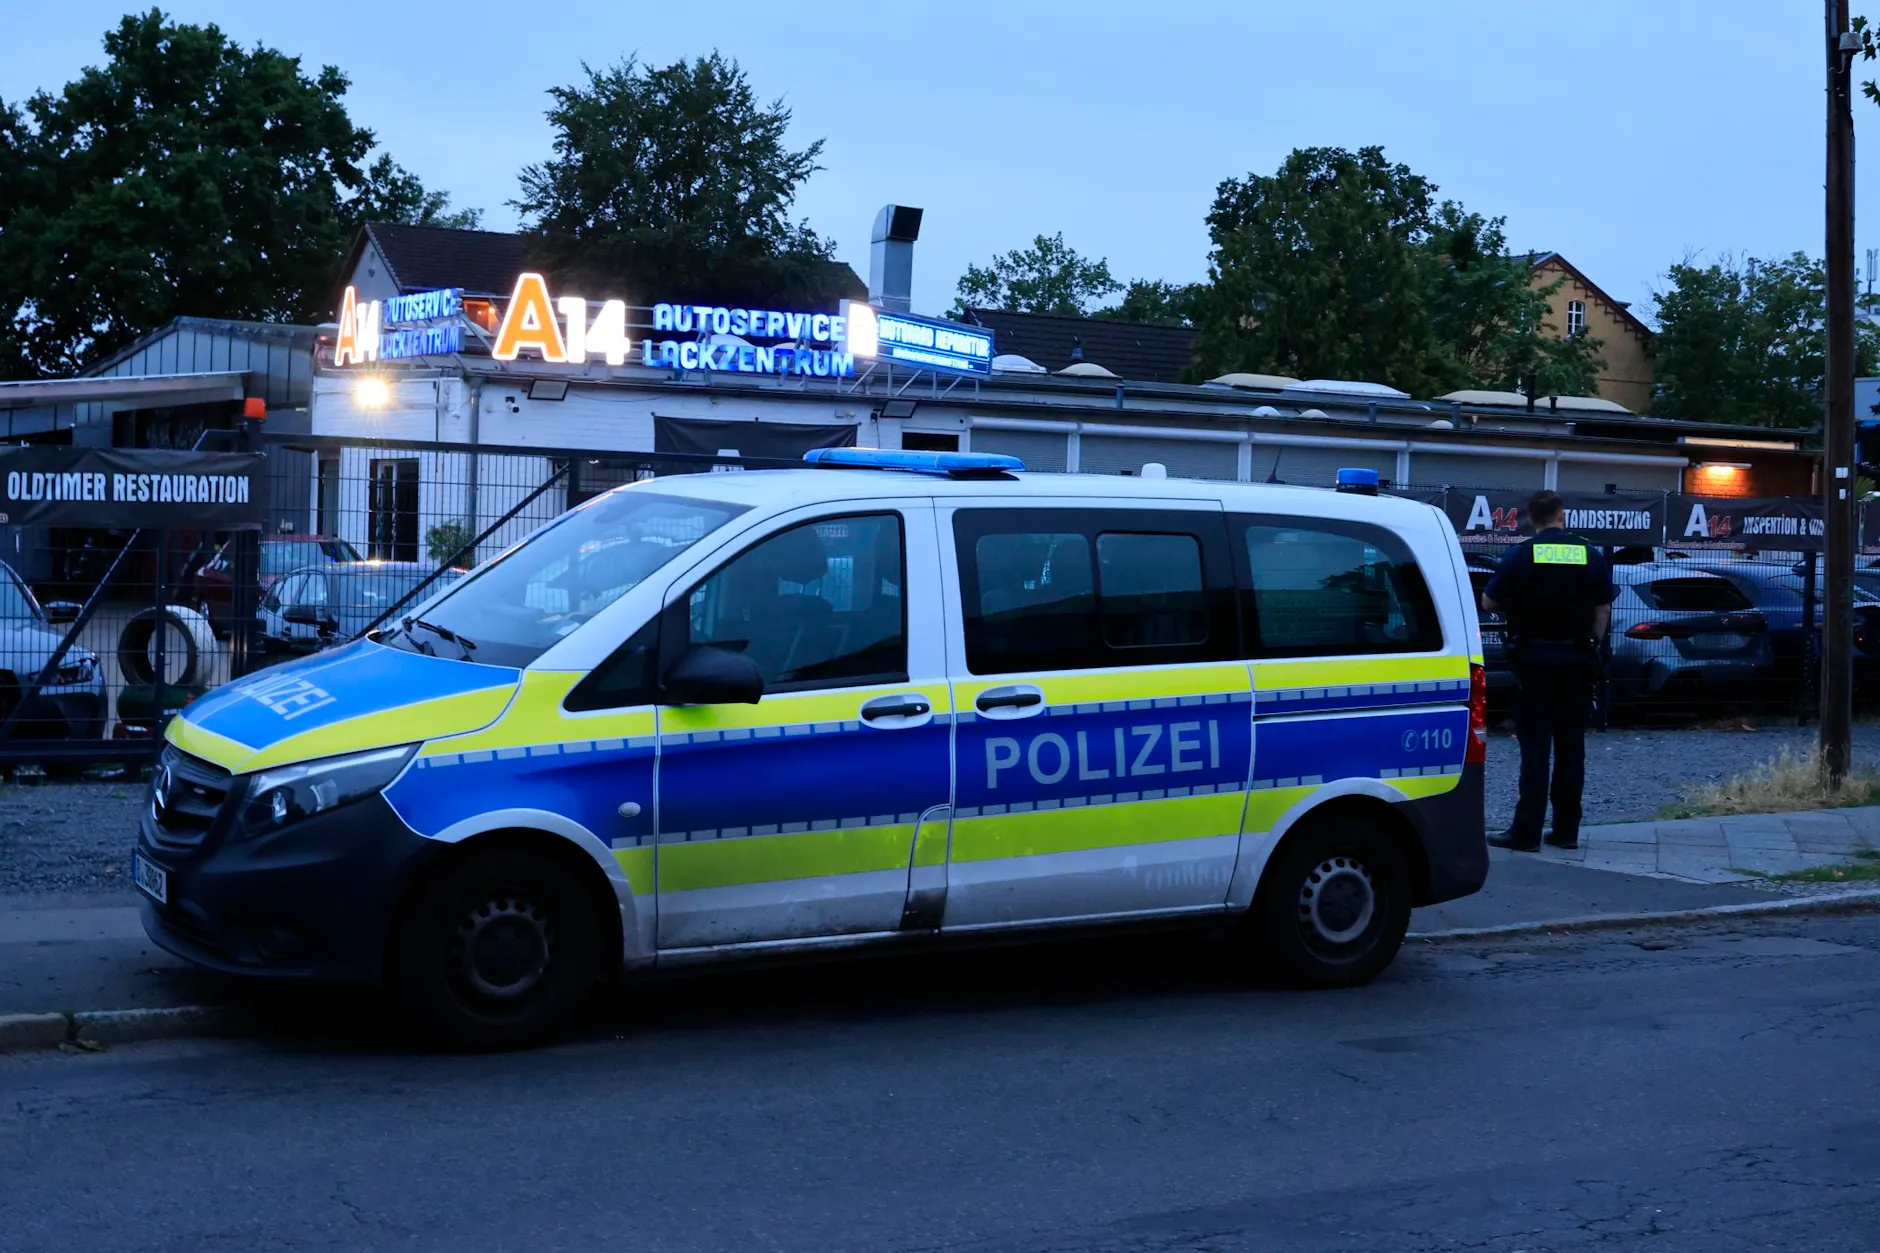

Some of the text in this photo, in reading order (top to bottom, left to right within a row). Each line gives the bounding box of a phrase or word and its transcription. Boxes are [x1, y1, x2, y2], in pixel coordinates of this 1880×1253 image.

[384, 288, 460, 323] AUTOSERVICE
[492, 272, 631, 366] A14
[653, 302, 847, 342] AUTOSERVICE
[335, 286, 379, 366] A14
[379, 326, 460, 359] LACKZENTRUM
[643, 339, 855, 378] LACKZENTRUM
[7, 471, 249, 504] OLDTIMER RESTAURATION
[1465, 495, 1519, 532] A14
[1563, 508, 1651, 531] TANDSETZUNG
[1684, 503, 1733, 538] A14
[1535, 545, 1586, 564] POLIZEI
[985, 719, 1221, 789] POLIZEI
[1420, 728, 1453, 751] 110
